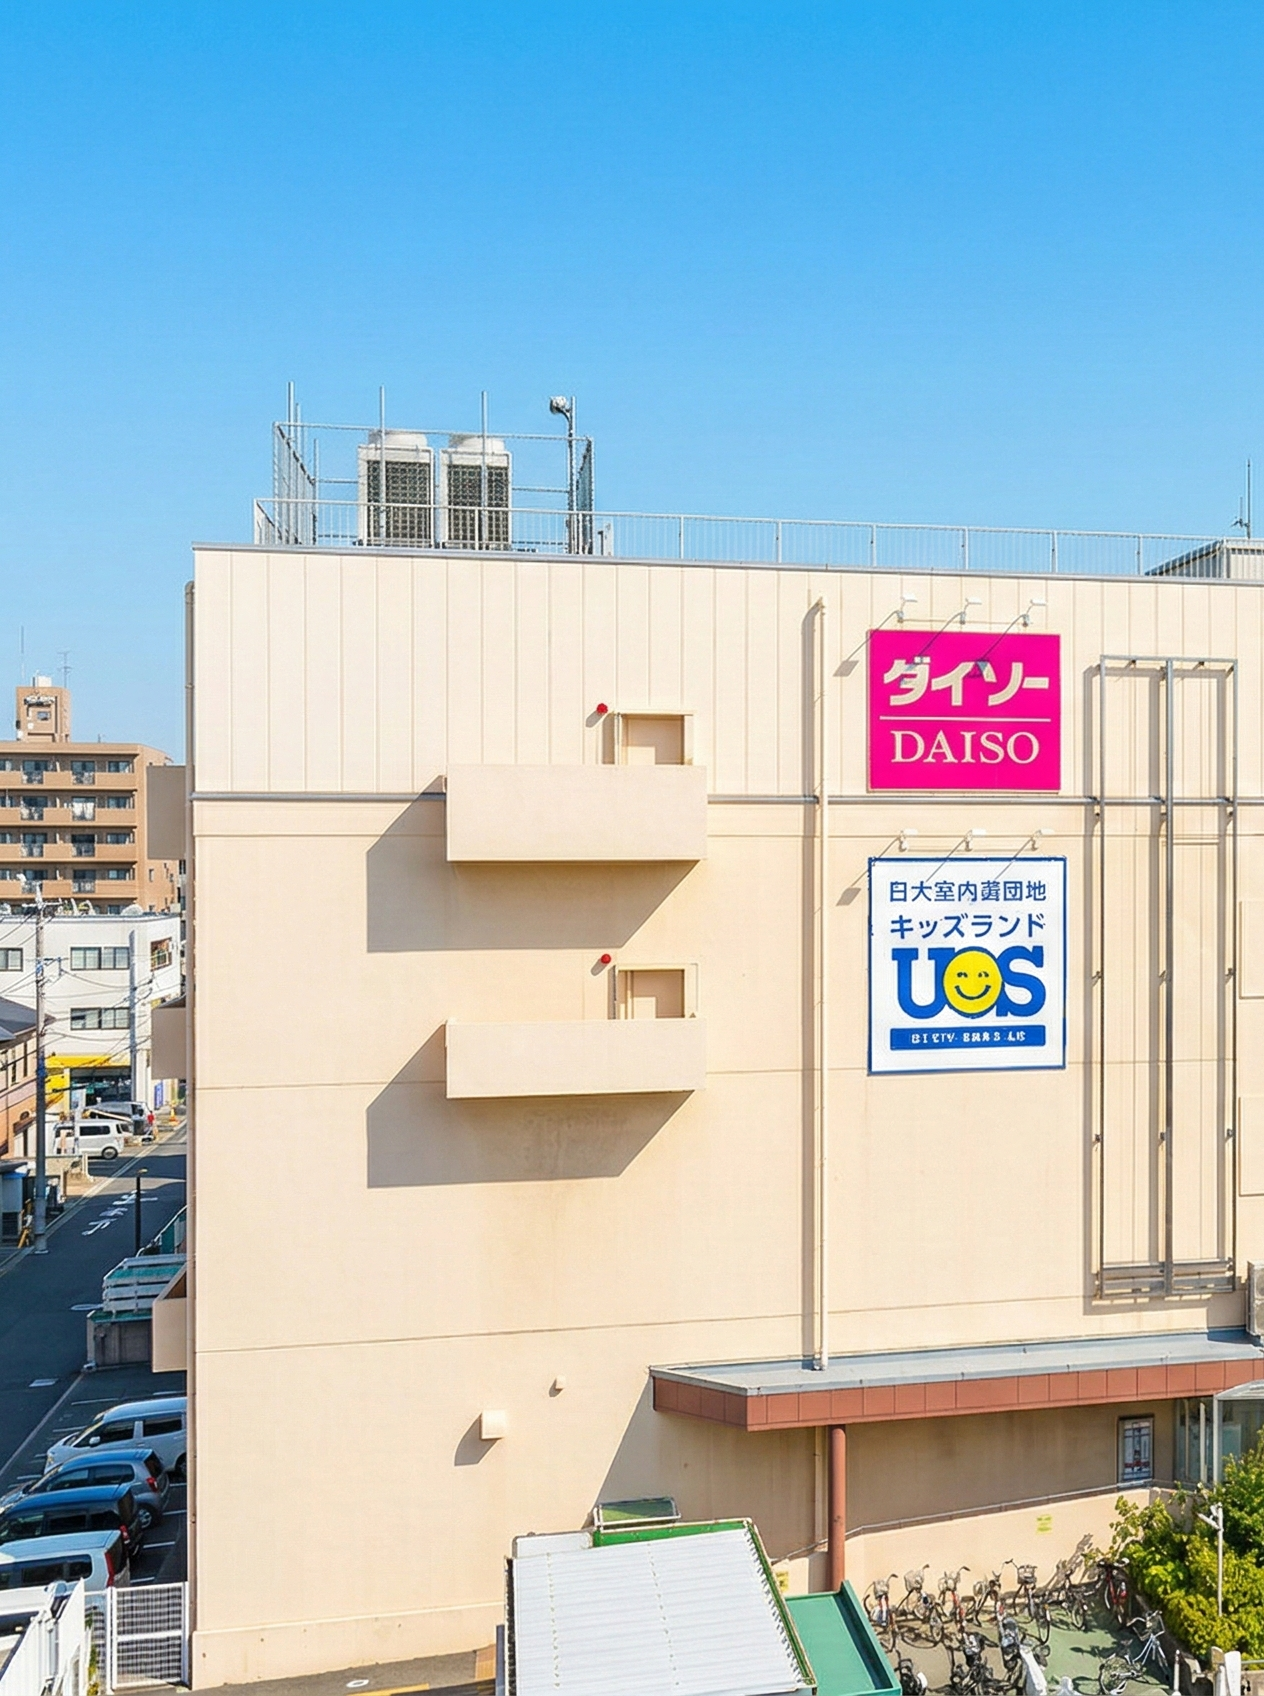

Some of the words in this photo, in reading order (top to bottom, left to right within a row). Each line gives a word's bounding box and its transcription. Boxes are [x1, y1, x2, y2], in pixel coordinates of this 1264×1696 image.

[882, 656, 1050, 707] ダイソー
[890, 729, 1040, 765] DAISO
[889, 912, 1047, 940] キッズランド
